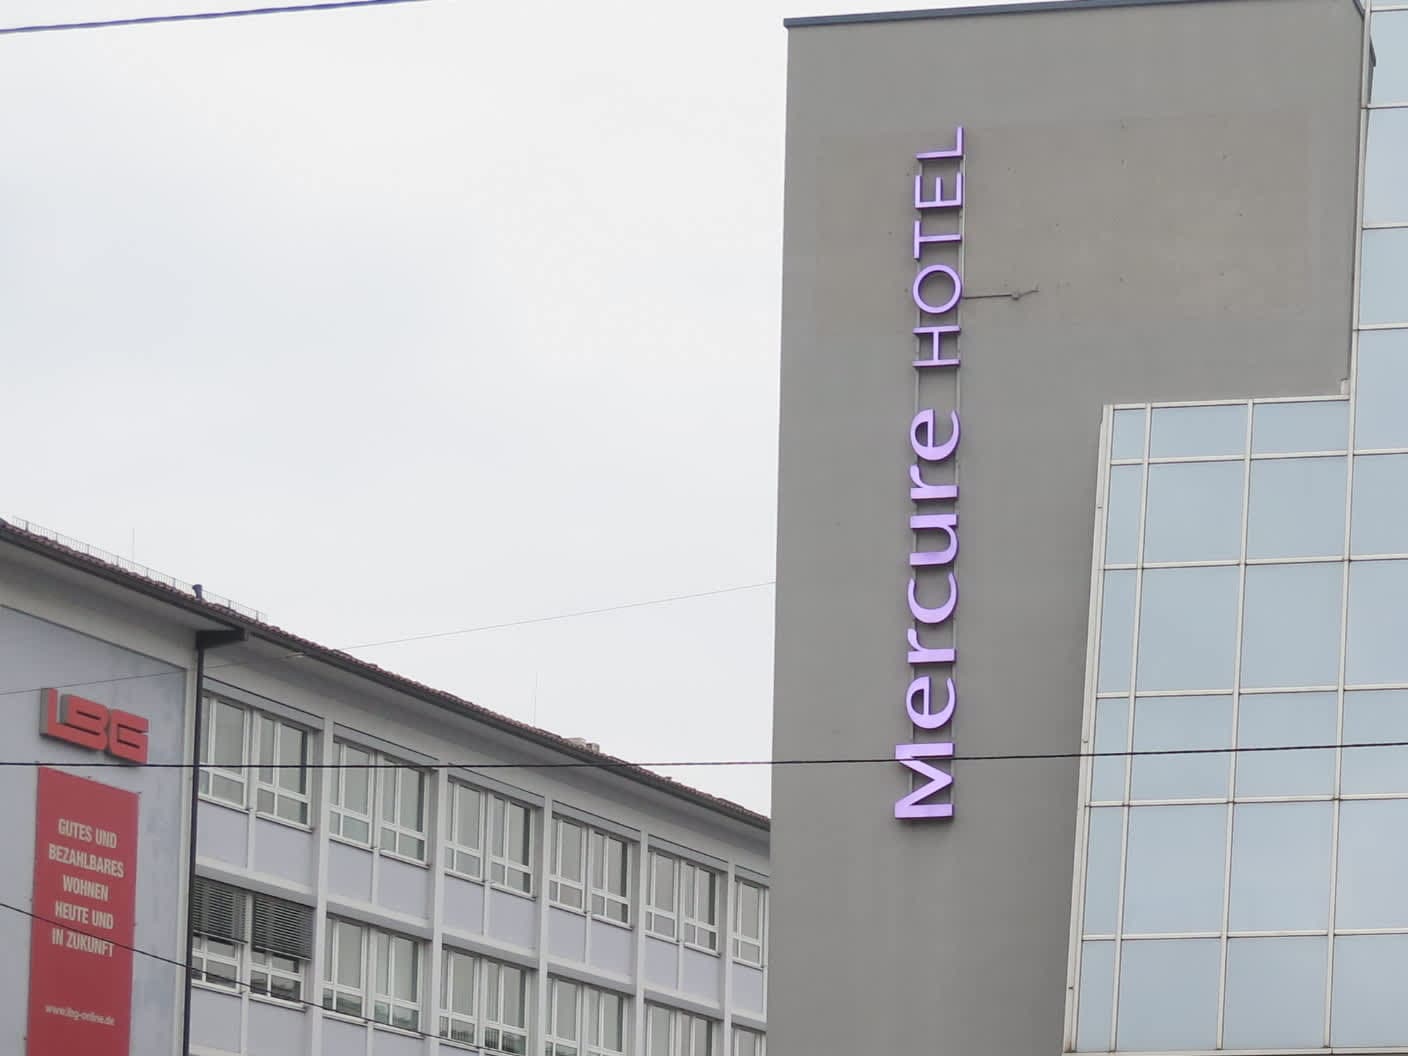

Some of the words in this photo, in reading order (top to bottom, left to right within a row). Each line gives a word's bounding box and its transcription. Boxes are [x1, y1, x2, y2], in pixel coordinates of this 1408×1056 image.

[912, 127, 964, 367] HOTEL
[895, 408, 960, 819] Mercure
[41, 688, 149, 765] LBG
[58, 818, 93, 842] GUTES
[95, 829, 117, 848] UND
[48, 843, 124, 878] BEZAHLBARES
[63, 874, 109, 901] WOHNEN
[55, 901, 89, 924] HEUTE
[92, 911, 114, 929] UND
[52, 928, 64, 945] IN
[66, 930, 115, 957] ZUKUNFT
